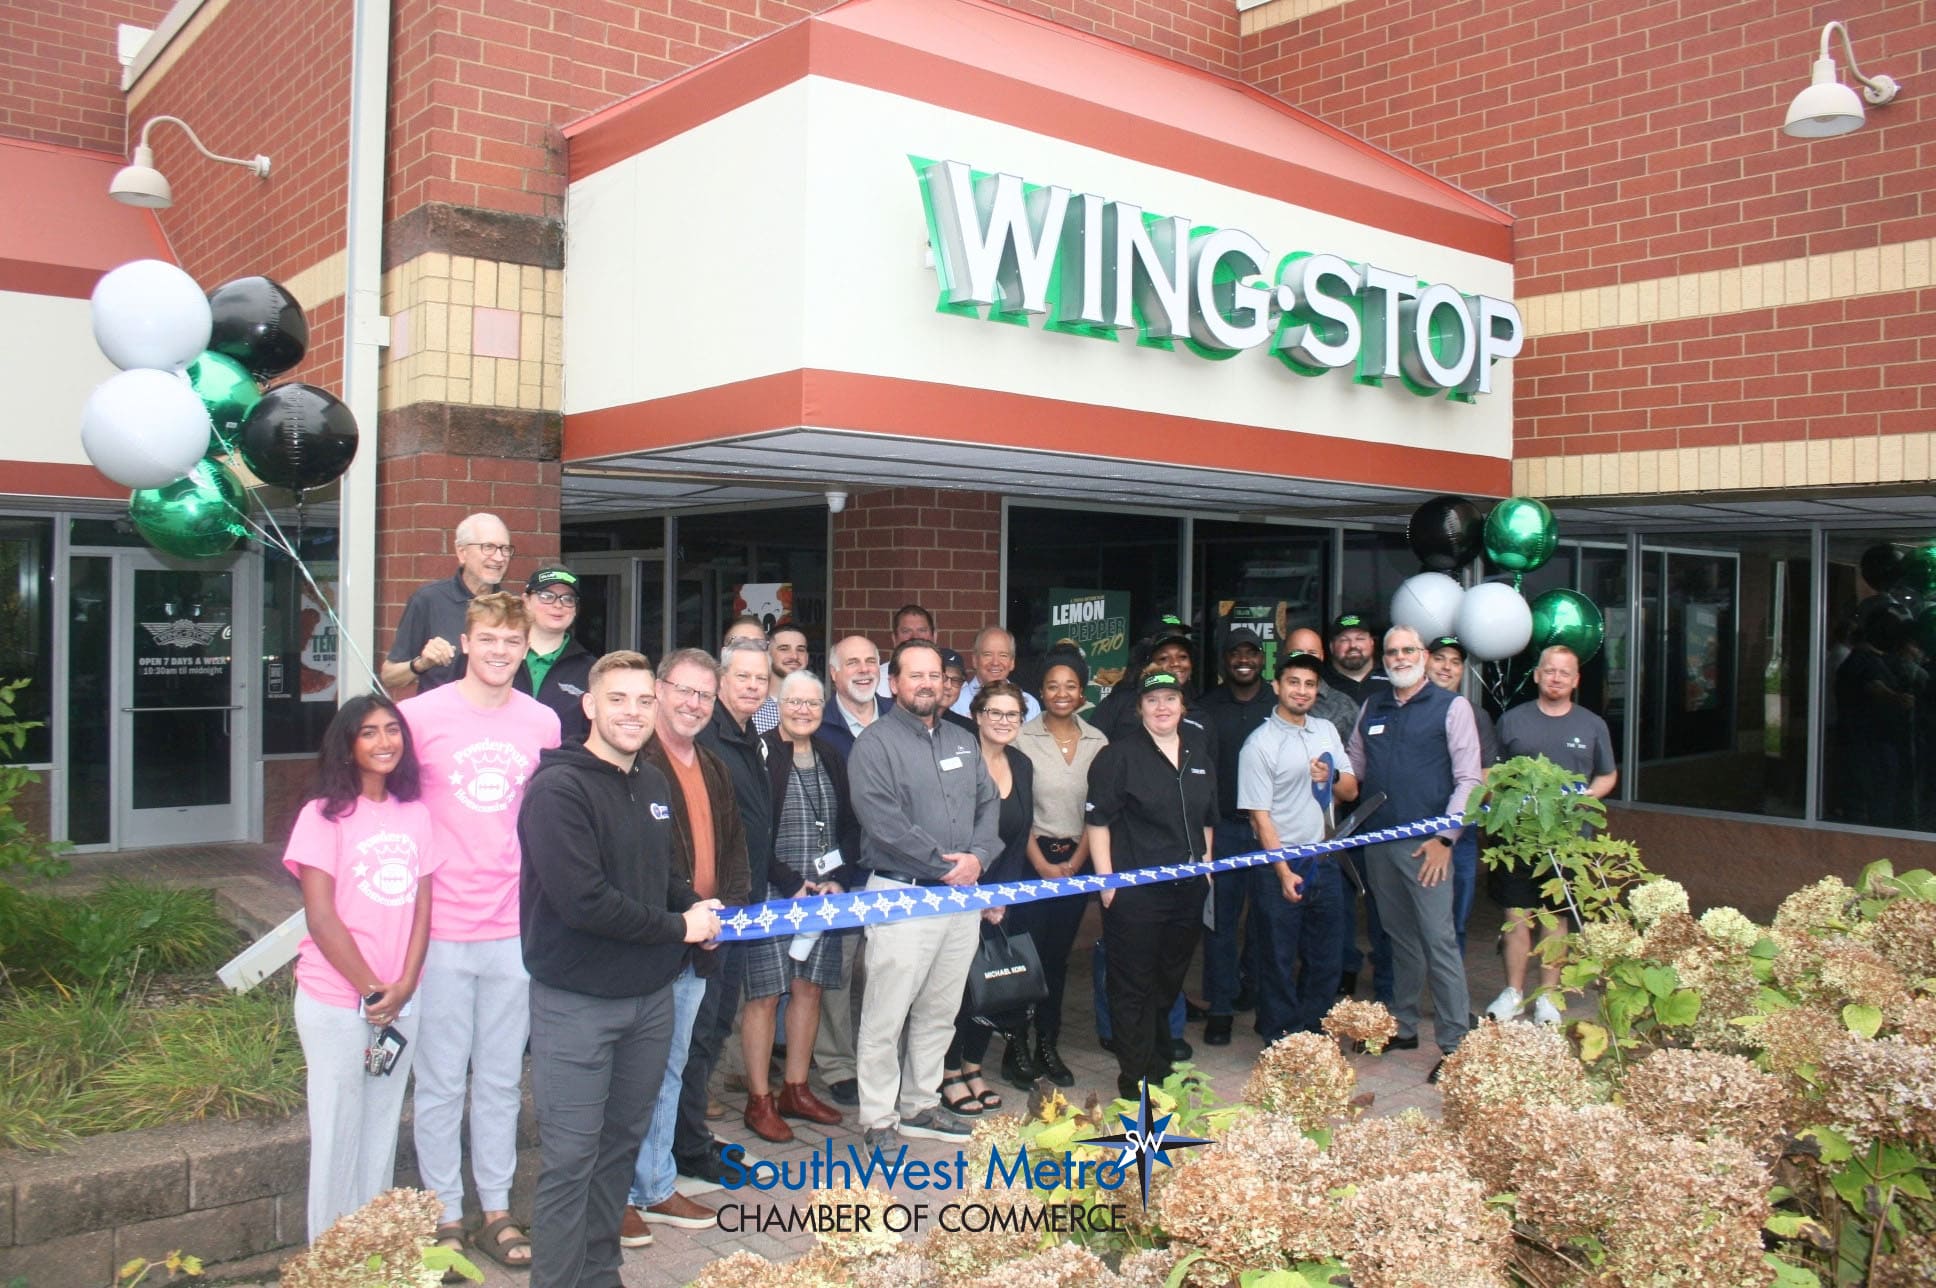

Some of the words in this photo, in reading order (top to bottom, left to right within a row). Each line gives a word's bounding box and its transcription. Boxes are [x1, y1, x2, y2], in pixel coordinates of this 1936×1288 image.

[1052, 600, 1105, 627] LEMON
[1069, 616, 1126, 642] PEPPER
[1091, 633, 1125, 656] TRIO
[139, 657, 162, 666] OPEN
[164, 657, 170, 666] 7
[171, 657, 193, 666] DAYS
[195, 657, 202, 665] A
[204, 657, 226, 665] WEEK
[189, 666, 223, 676] midnight
[984, 968, 1011, 979] MICHAEL
[1011, 965, 1027, 974] KORS
